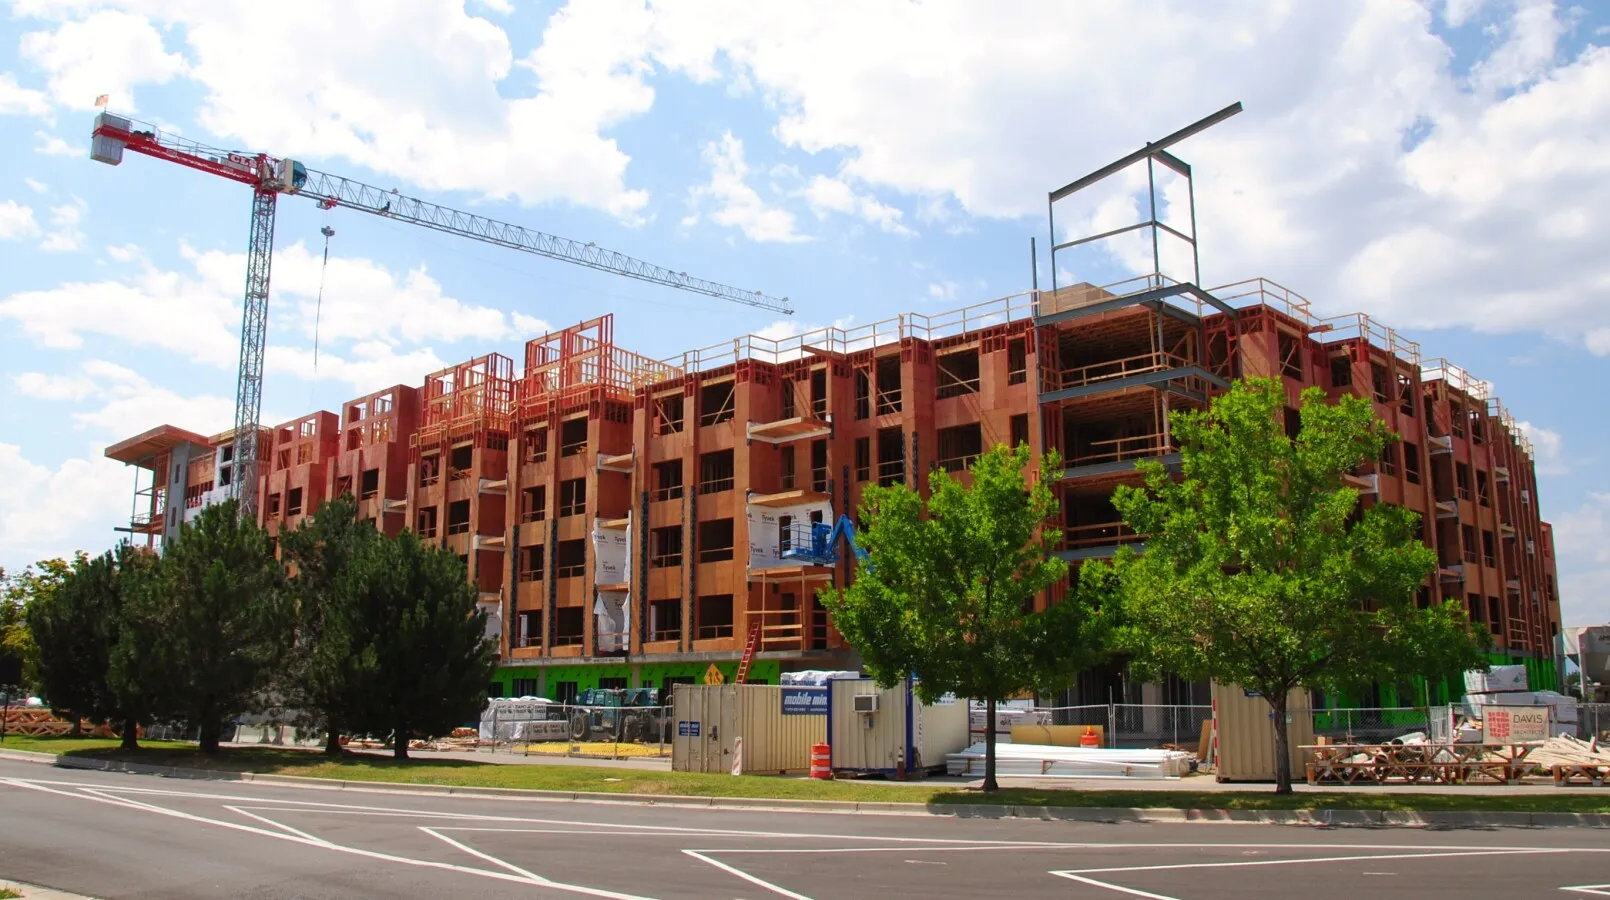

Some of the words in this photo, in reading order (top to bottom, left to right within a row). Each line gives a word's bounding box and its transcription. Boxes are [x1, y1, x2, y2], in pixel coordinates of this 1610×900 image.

[750, 546, 763, 554] Tyvek
[784, 692, 811, 705] mobile
[811, 694, 827, 705] min
[1513, 714, 1543, 723] DAVIS
